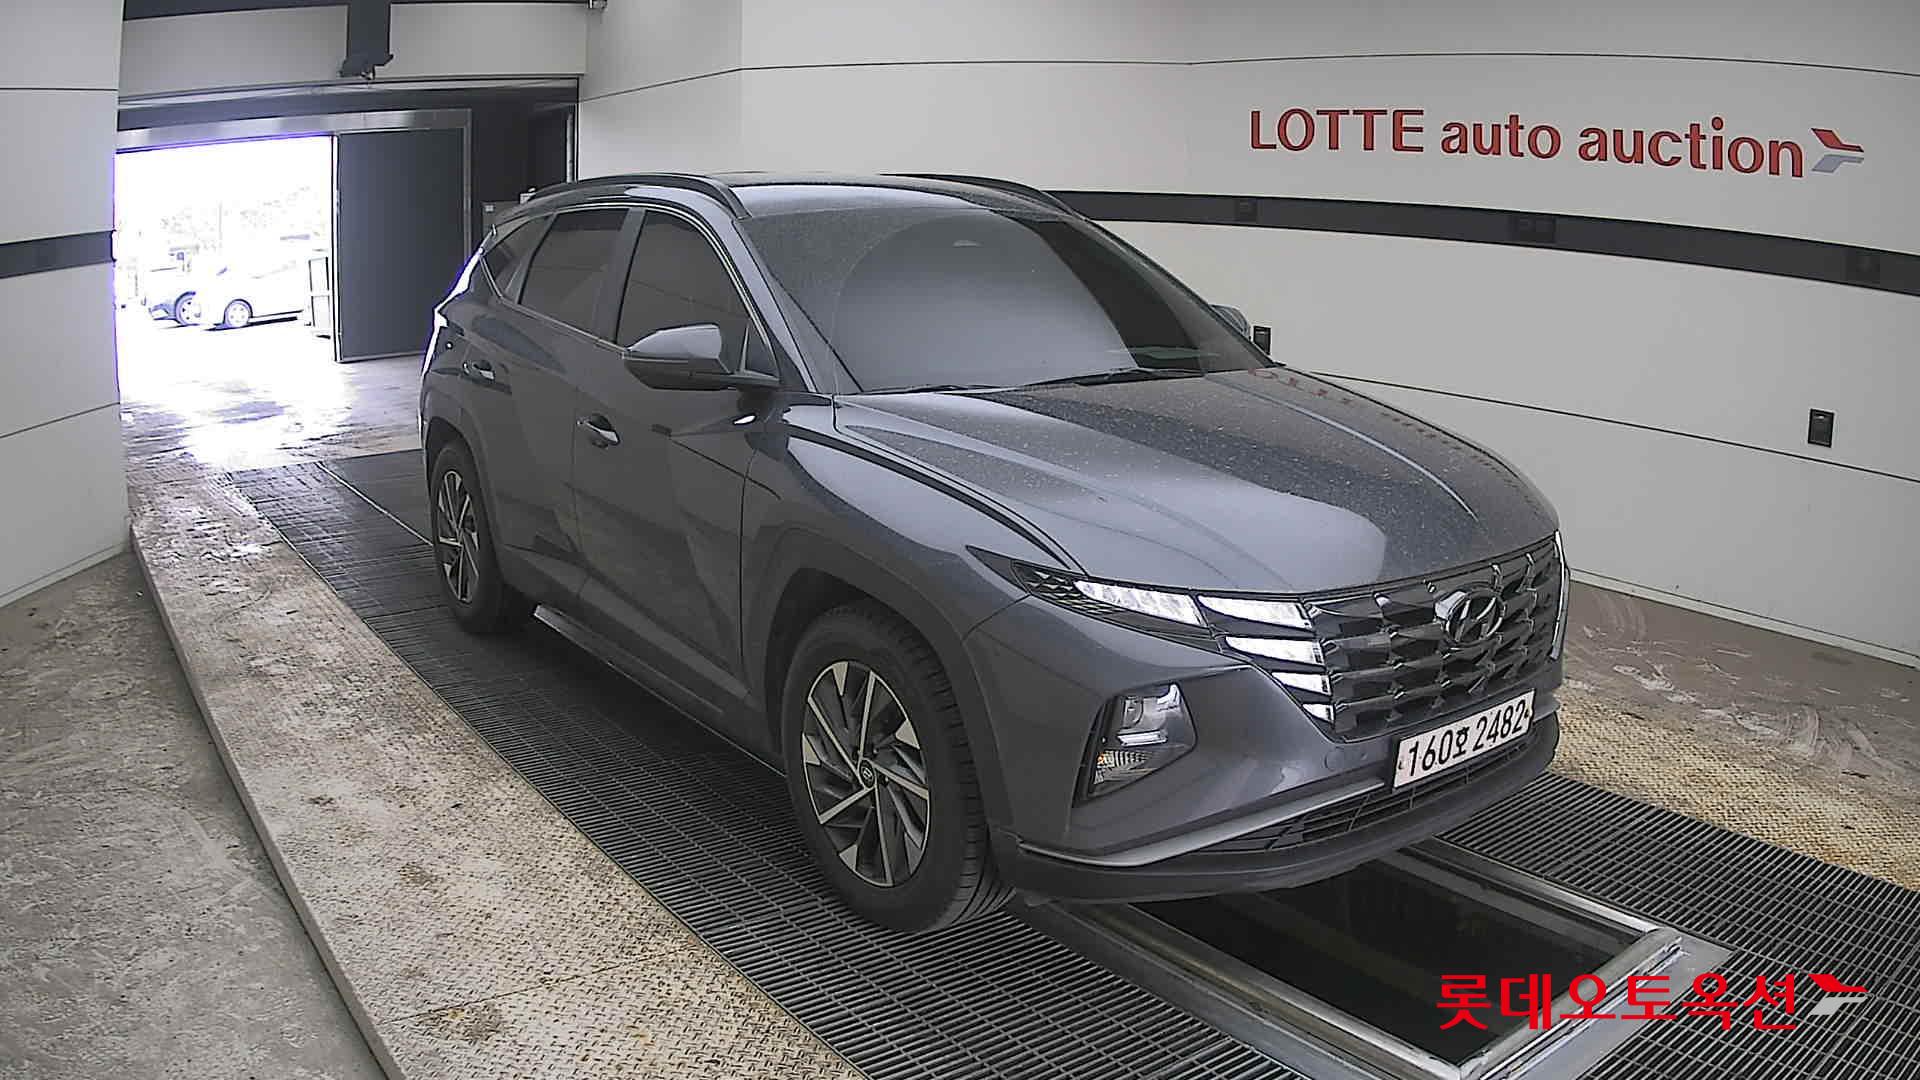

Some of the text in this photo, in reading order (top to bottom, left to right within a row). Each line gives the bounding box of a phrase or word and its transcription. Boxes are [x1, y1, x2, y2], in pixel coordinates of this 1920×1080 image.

[1250, 108, 1804, 178] LOTTE auto auction
[1409, 699, 1526, 777] 160호 2482
